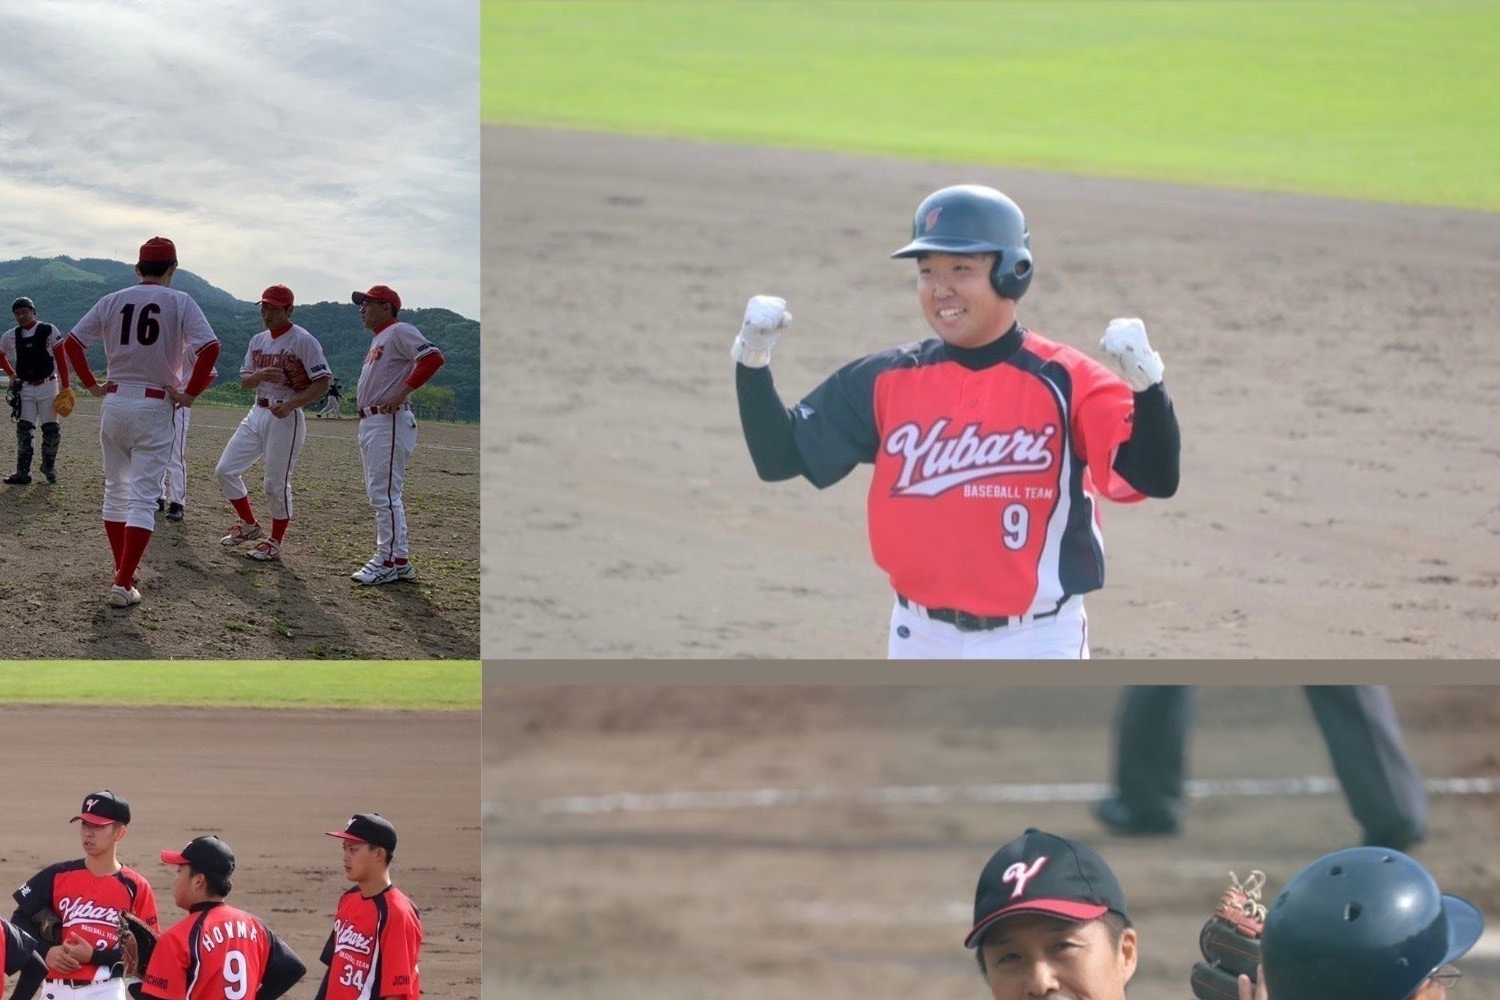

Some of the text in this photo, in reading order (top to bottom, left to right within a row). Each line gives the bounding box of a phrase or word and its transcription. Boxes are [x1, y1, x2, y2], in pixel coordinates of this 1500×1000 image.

[120, 303, 160, 345] 16
[885, 418, 1057, 498] Yubari
[963, 484, 1053, 500] BASEBALL TEAM
[1002, 502, 1029, 550] 9
[86, 799, 99, 812] Y
[1002, 857, 1048, 898] Y
[222, 950, 248, 1000] 9
[338, 964, 364, 991] 34
